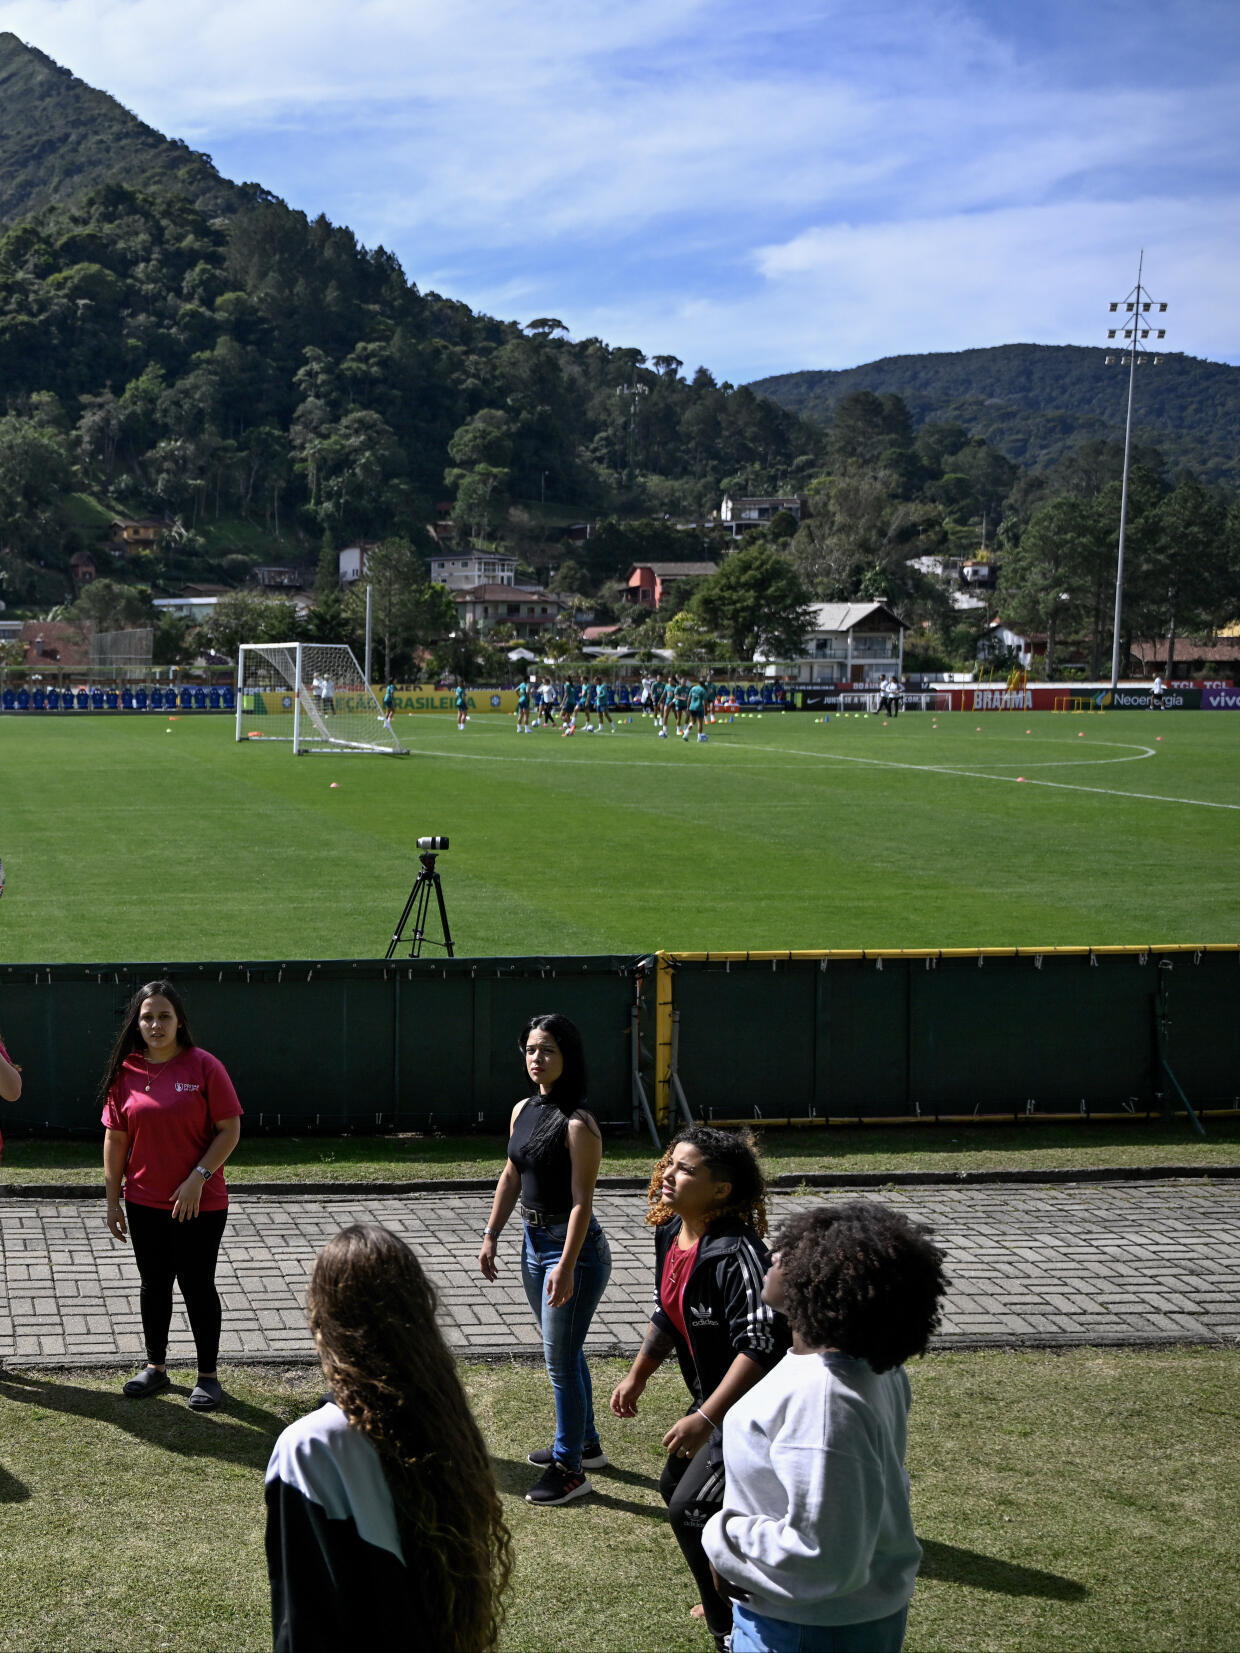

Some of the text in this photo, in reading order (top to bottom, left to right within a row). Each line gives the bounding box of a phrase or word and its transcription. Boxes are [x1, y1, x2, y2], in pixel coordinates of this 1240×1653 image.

[378, 684, 423, 692] CMED
[382, 697, 477, 710] RASILEIA
[974, 691, 1032, 709] BRAHMA
[692, 1319, 719, 1327] adidas
[681, 1520, 705, 1528] adida
